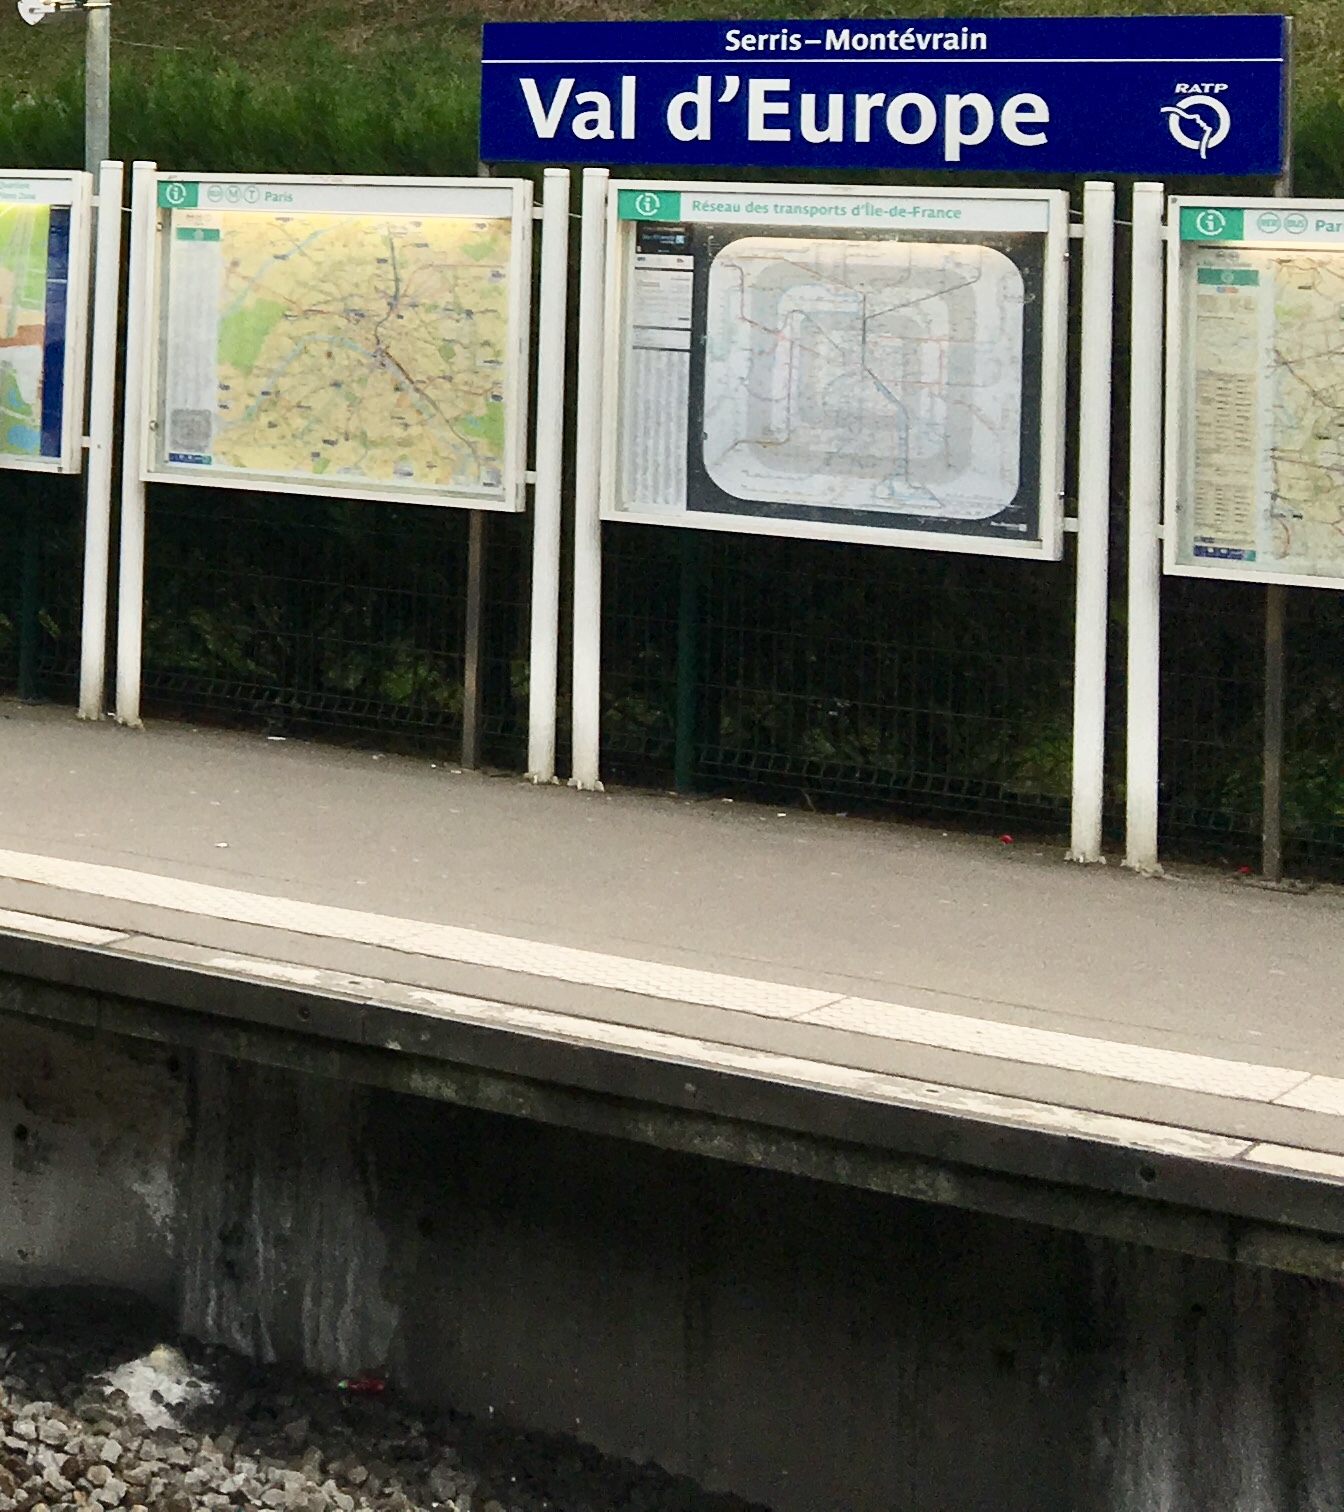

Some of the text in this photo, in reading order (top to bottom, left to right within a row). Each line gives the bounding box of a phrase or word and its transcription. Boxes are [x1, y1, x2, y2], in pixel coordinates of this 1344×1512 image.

[1174, 82, 1229, 94] RATP
[519, 75, 1050, 162] Val d’Europe
[264, 191, 294, 202] Paris
[691, 199, 741, 213] Réseau
[745, 201, 769, 213] des
[773, 203, 847, 217] transports
